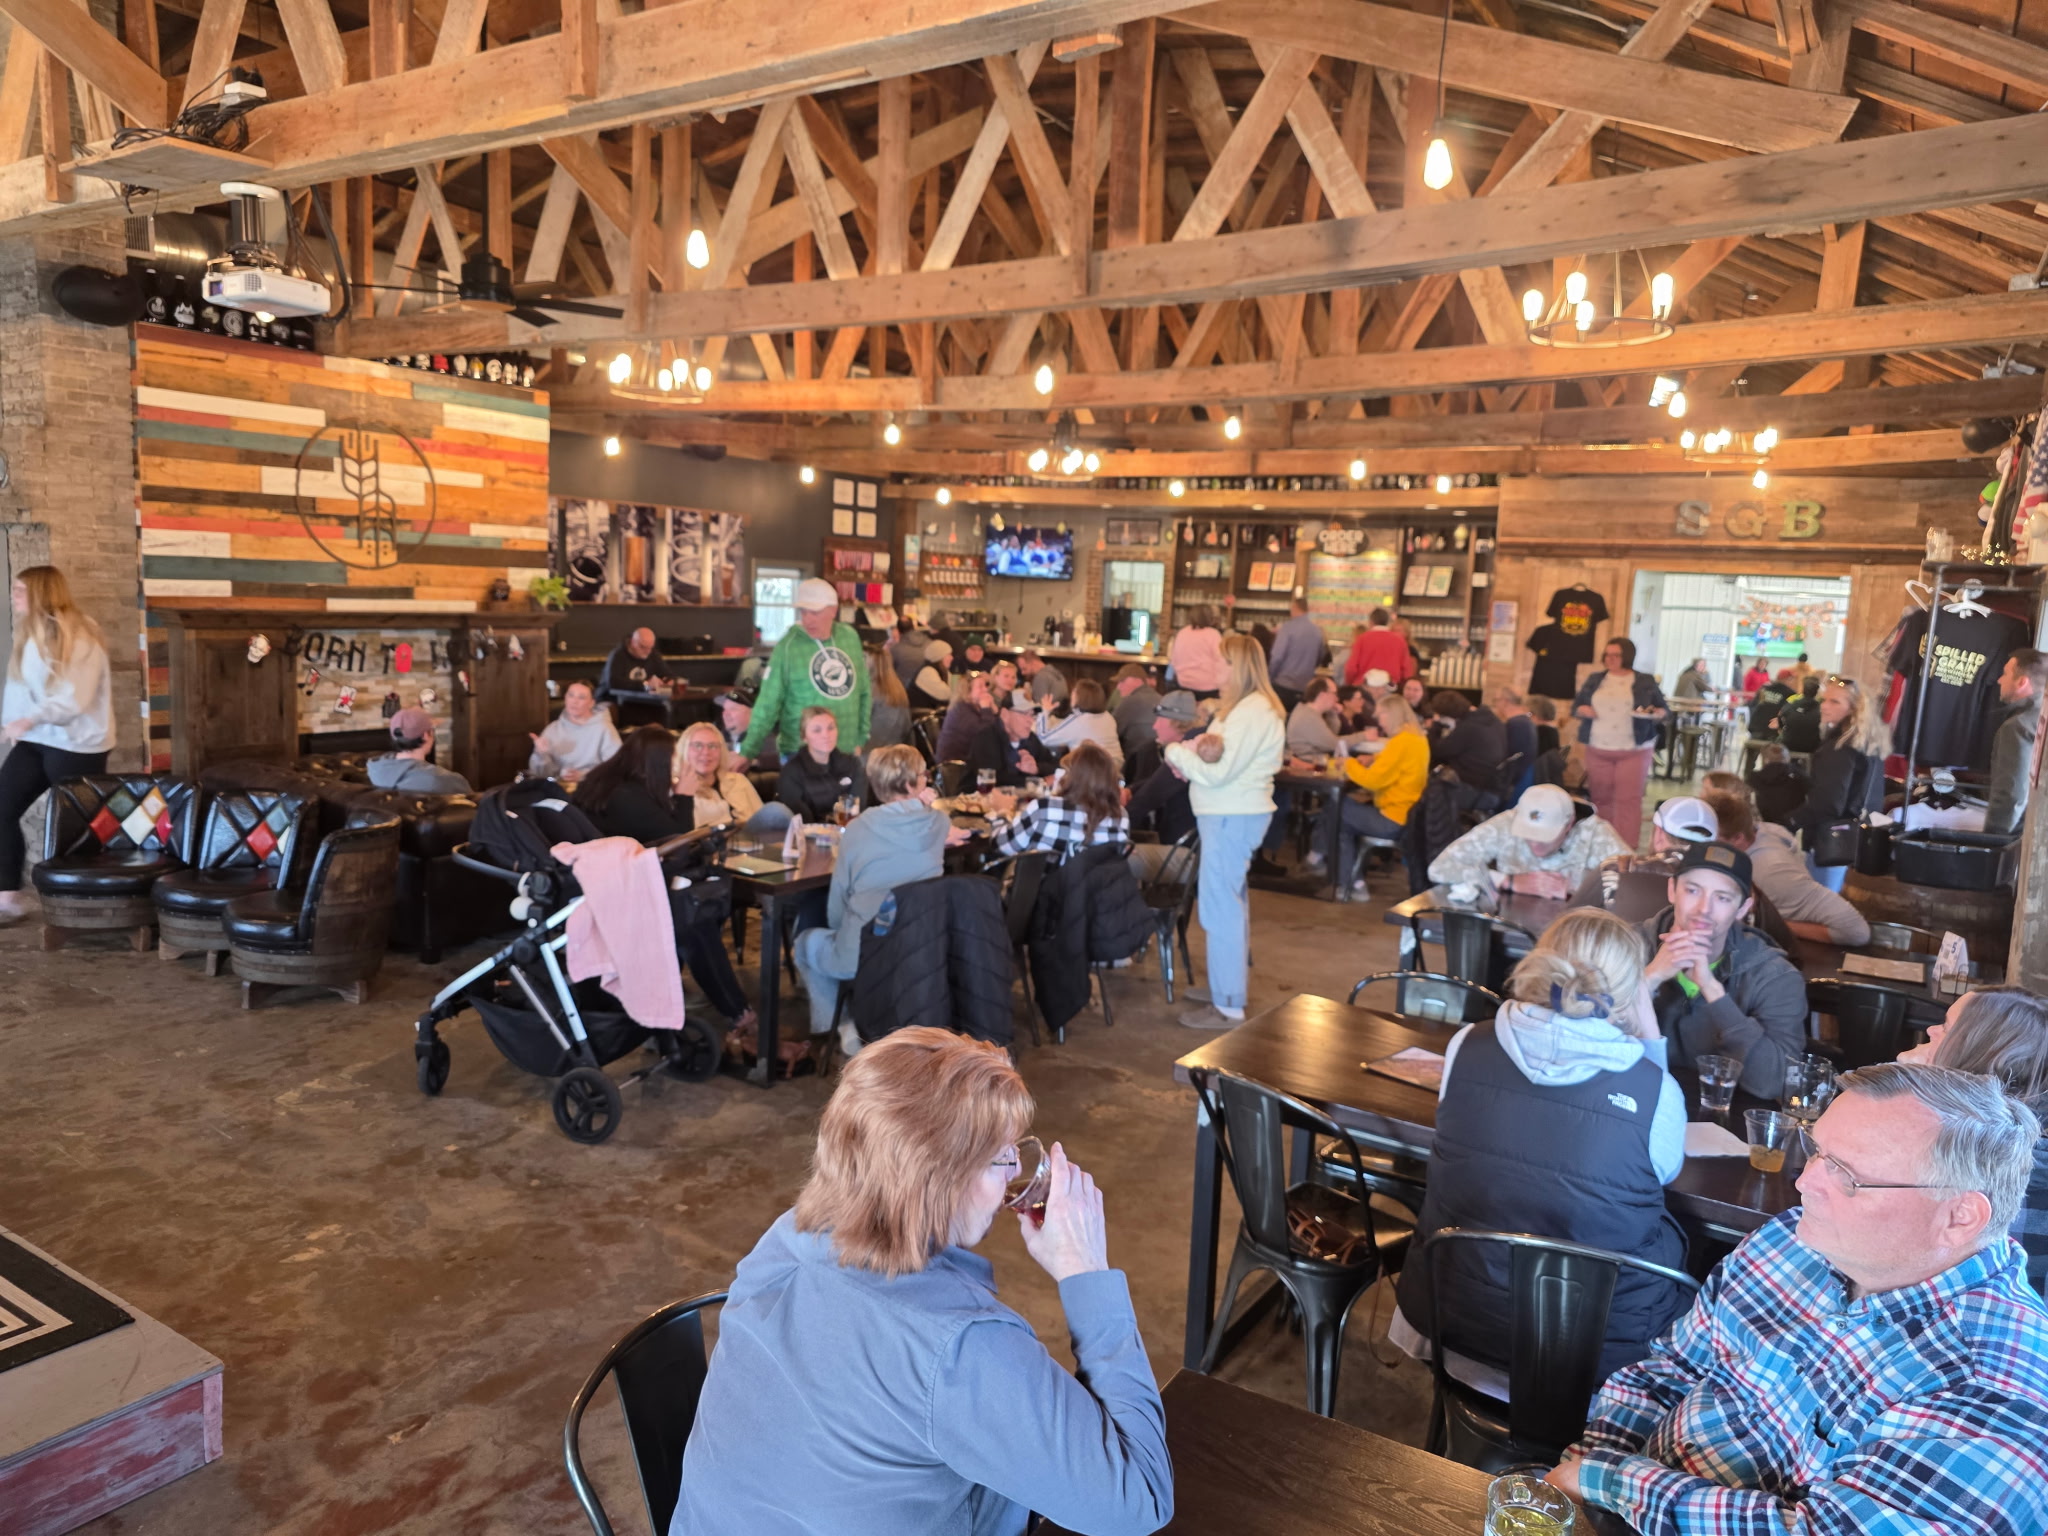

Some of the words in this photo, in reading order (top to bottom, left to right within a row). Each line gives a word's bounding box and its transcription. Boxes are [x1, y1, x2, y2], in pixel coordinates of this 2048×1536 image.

[1319, 529, 1364, 543] ORDER
[1323, 542, 1358, 555] HERE
[1934, 644, 1987, 666] SPILLED
[1938, 656, 1981, 674] GRAIN
[1951, 942, 1958, 954] 5
